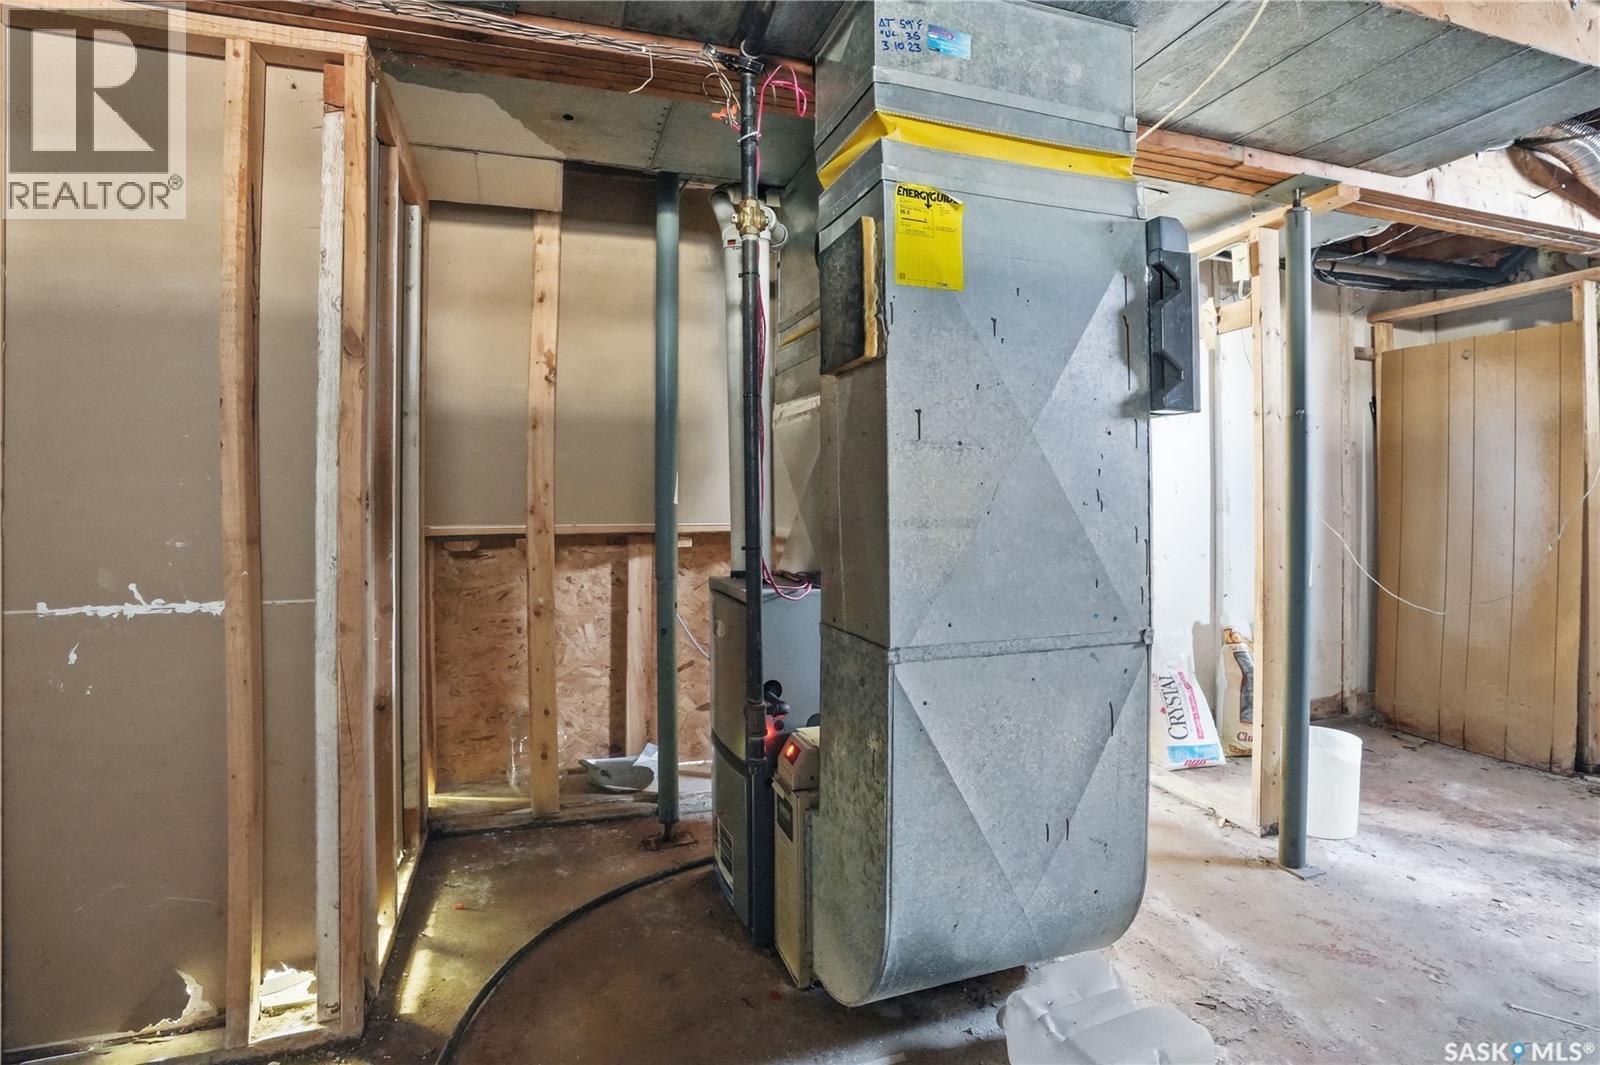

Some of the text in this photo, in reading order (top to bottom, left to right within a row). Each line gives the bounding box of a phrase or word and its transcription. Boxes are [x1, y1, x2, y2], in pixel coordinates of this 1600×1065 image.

[881, 40, 922, 52] 3 10 23
